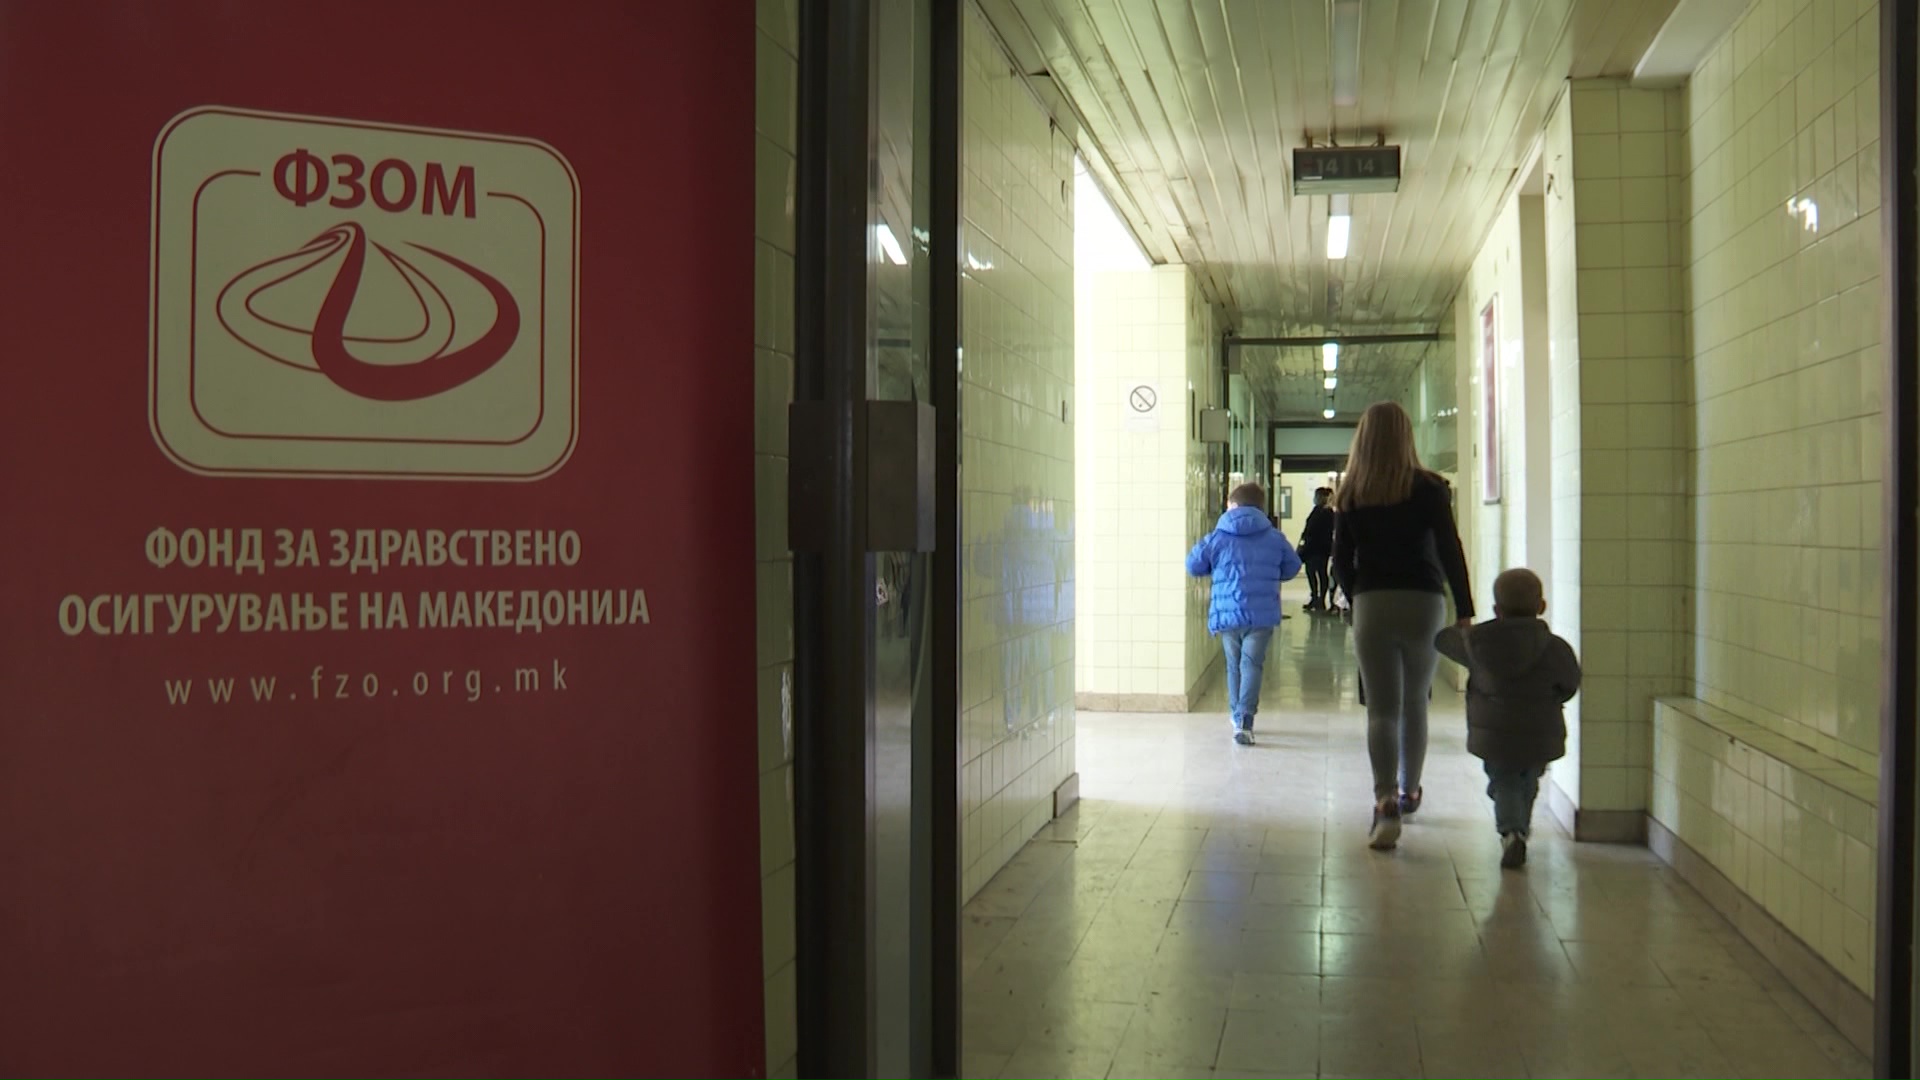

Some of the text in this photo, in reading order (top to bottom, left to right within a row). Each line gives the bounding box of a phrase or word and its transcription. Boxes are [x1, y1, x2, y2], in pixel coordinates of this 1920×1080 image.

[273, 148, 476, 218] ФЗОМ
[1316, 157, 1375, 175] 14 14
[145, 526, 580, 574] ФОНД ЗА ЗДРАВСТВЕНО
[59, 590, 649, 635] ОСИГУРУВАЊЕ НА МАКЕДОНИЈА
[165, 659, 568, 705] www.fzo.org.mk
